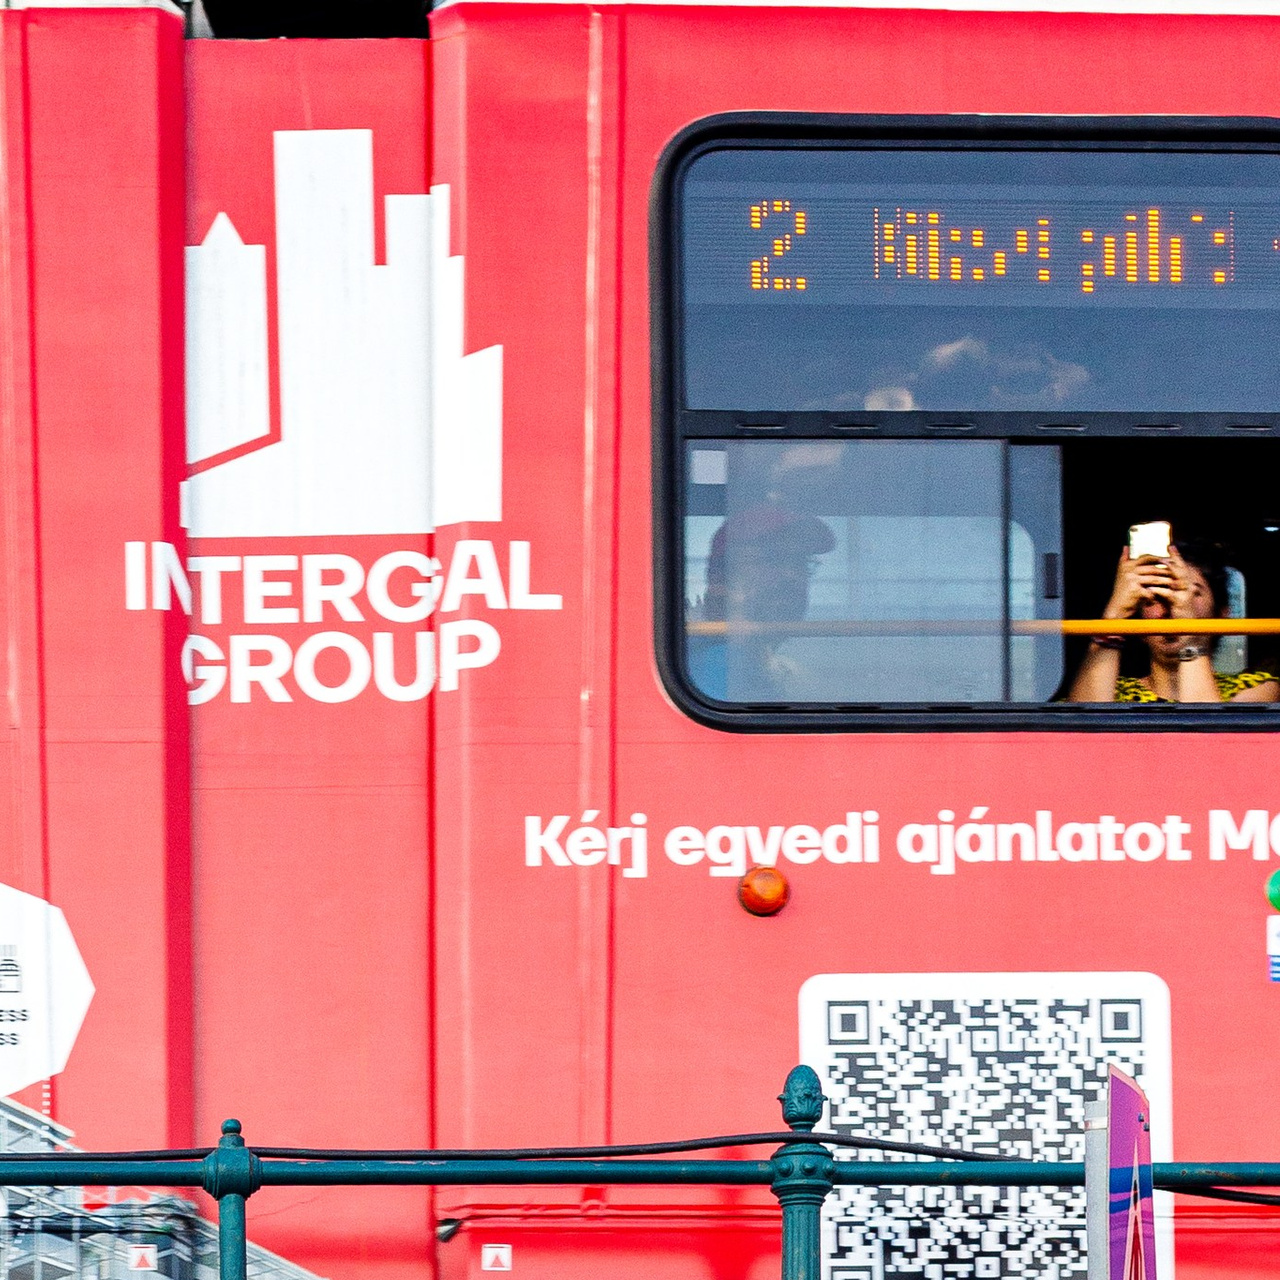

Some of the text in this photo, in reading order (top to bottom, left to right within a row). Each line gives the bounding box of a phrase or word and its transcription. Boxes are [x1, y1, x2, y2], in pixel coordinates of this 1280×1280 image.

[751, 201, 807, 290] 2
[124, 540, 563, 624] INTERGAL
[181, 619, 501, 706] GROUP
[524, 810, 648, 878] Kérj
[896, 806, 1192, 874] ajánlatot
[1208, 809, 1280, 861] M
